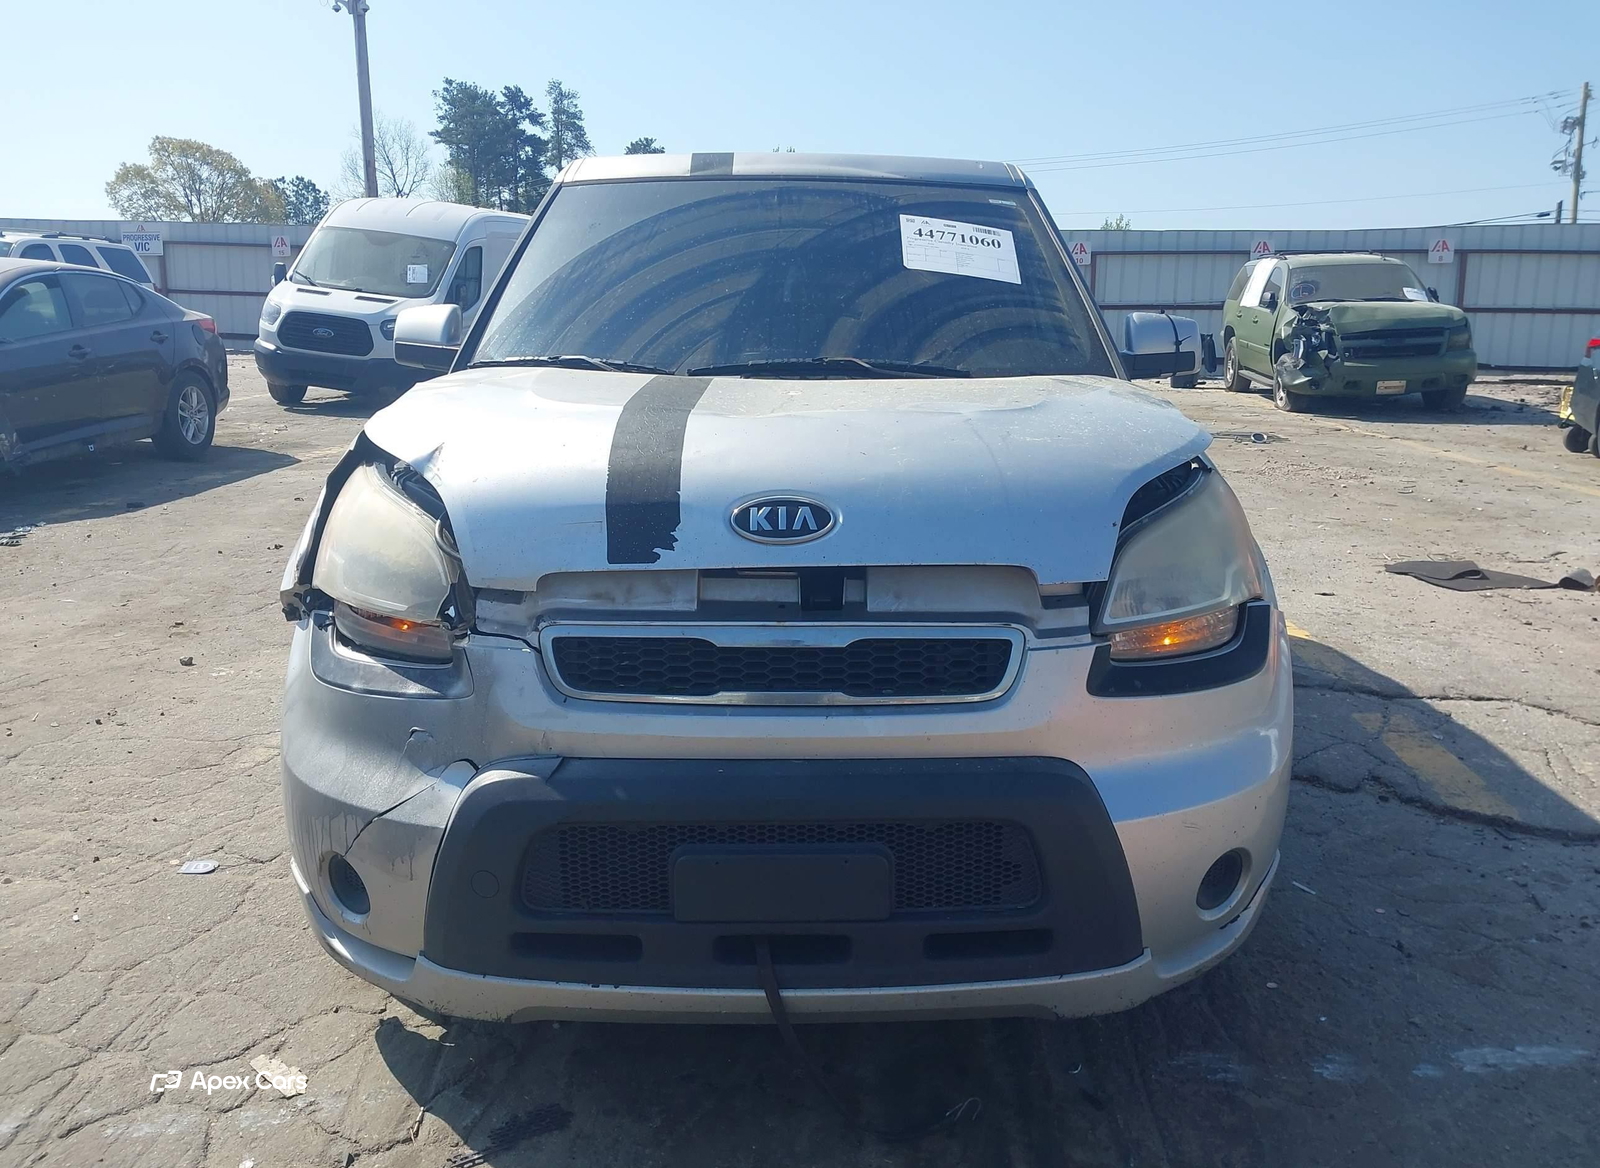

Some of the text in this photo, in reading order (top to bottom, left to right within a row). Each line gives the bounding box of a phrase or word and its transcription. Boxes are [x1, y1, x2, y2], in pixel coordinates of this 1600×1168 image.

[134, 241, 150, 252] VIC
[913, 227, 1002, 249] 44771060
[748, 506, 818, 531] KIA
